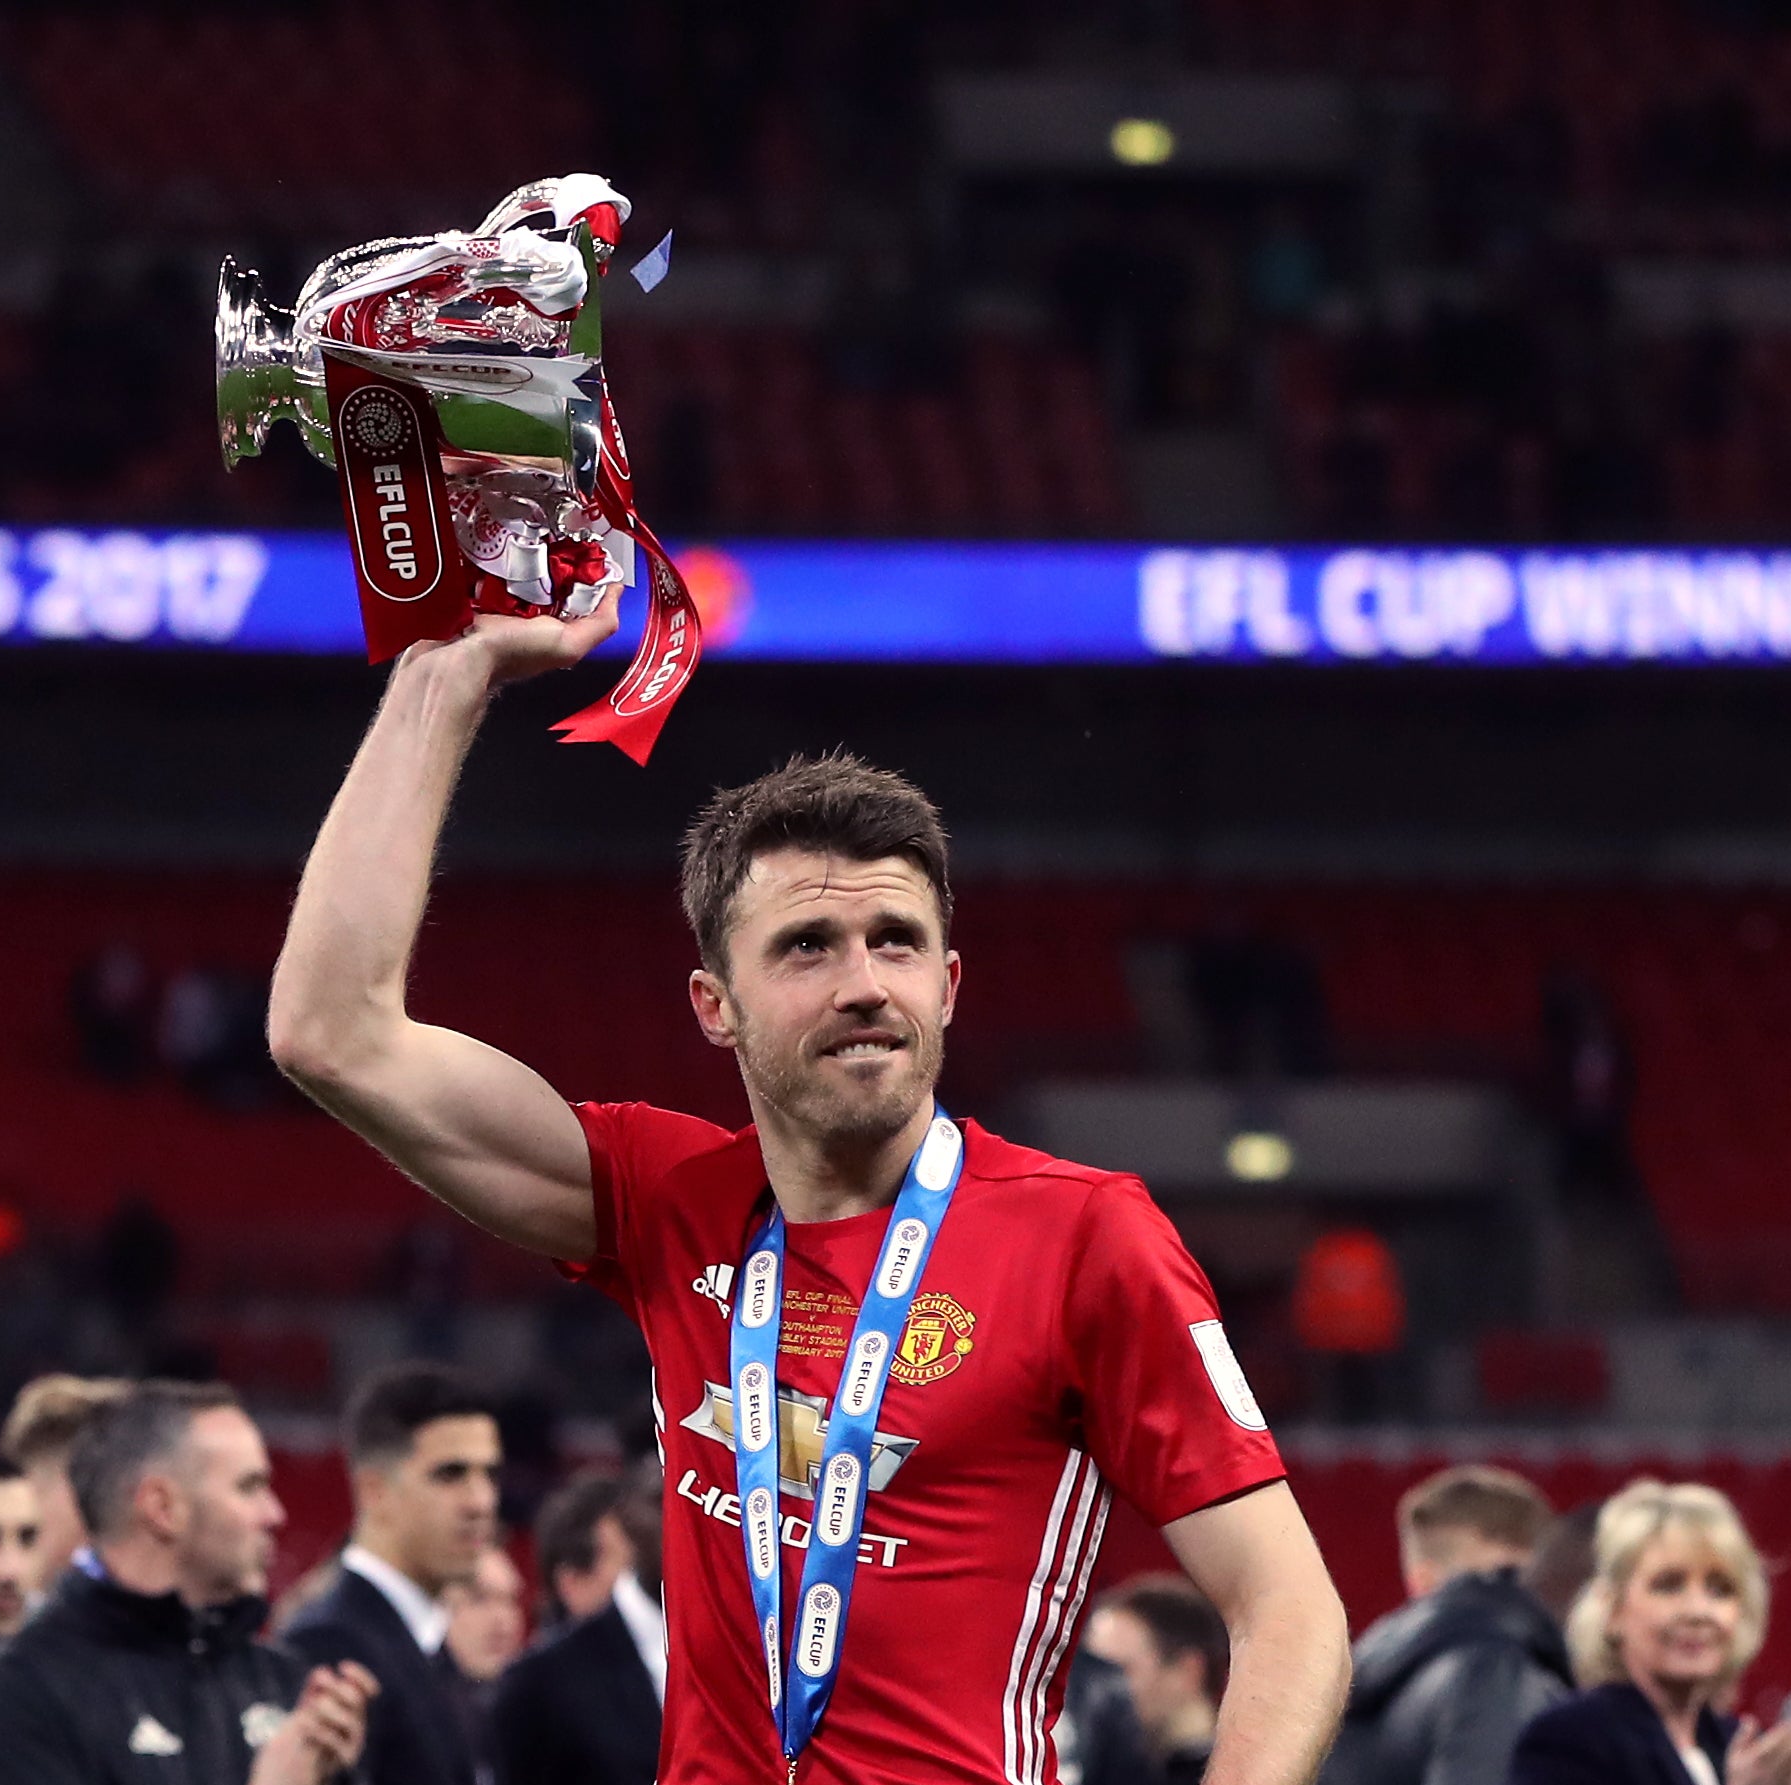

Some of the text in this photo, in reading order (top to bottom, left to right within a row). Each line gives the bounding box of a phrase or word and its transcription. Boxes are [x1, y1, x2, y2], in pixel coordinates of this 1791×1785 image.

[26, 526, 270, 644] 2017
[1137, 547, 1312, 660] EFL
[1316, 548, 1513, 662] CUP
[781, 1320, 843, 1336] OUTHAMPTON
[890, 1360, 945, 1379] UNITED
